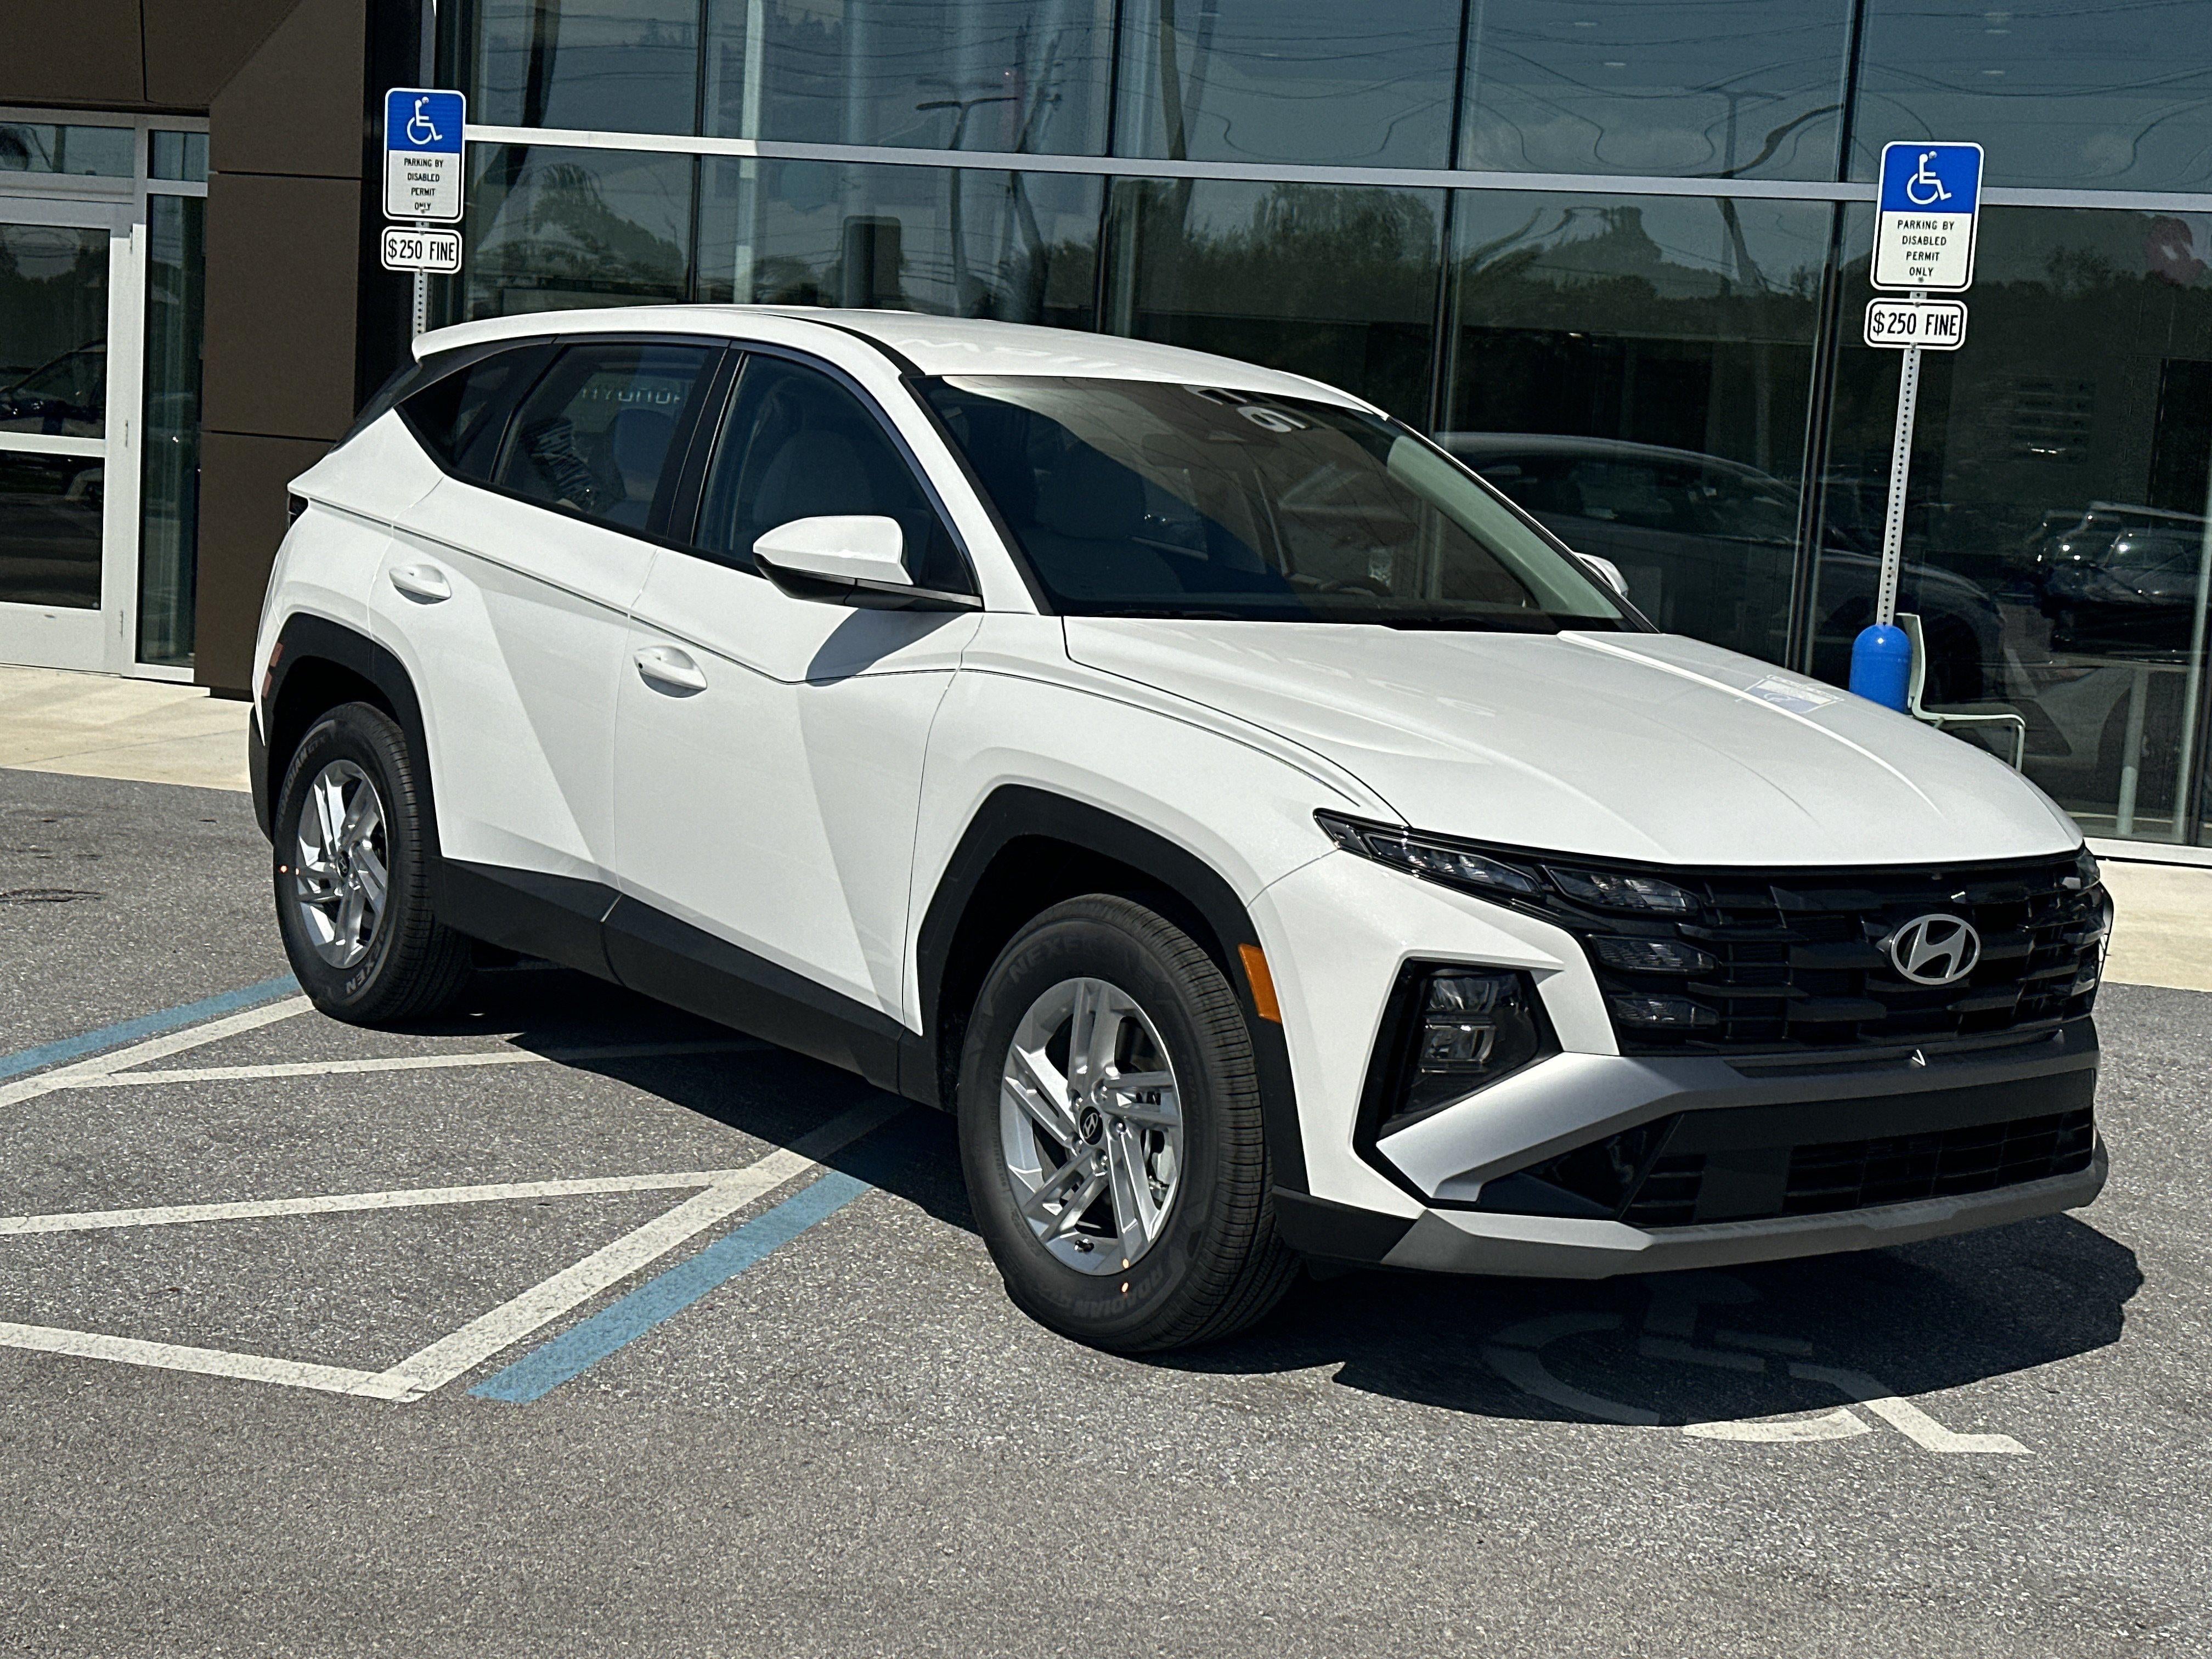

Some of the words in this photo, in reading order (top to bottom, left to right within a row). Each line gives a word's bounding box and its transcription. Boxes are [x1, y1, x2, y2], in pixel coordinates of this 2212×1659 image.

[404, 157, 432, 167] PARKING
[435, 159, 444, 168] BY
[407, 173, 440, 182] DISABLED
[411, 187, 436, 196] PERMIT
[415, 202, 432, 211] ONLY
[1897, 219, 1938, 230] PARKING
[1942, 221, 1955, 230] BY
[1901, 235, 1947, 246] DISABLED
[387, 238, 422, 261] $250
[430, 241, 455, 261] FINE
[1905, 252, 1940, 262] PERMIT
[1909, 267, 1934, 277] ONLY
[1872, 309, 1917, 336] $250
[1925, 313, 1959, 336] FINE
[346, 921, 387, 995] NEXEN
[1071, 1263, 1164, 1317] ROADIAN
